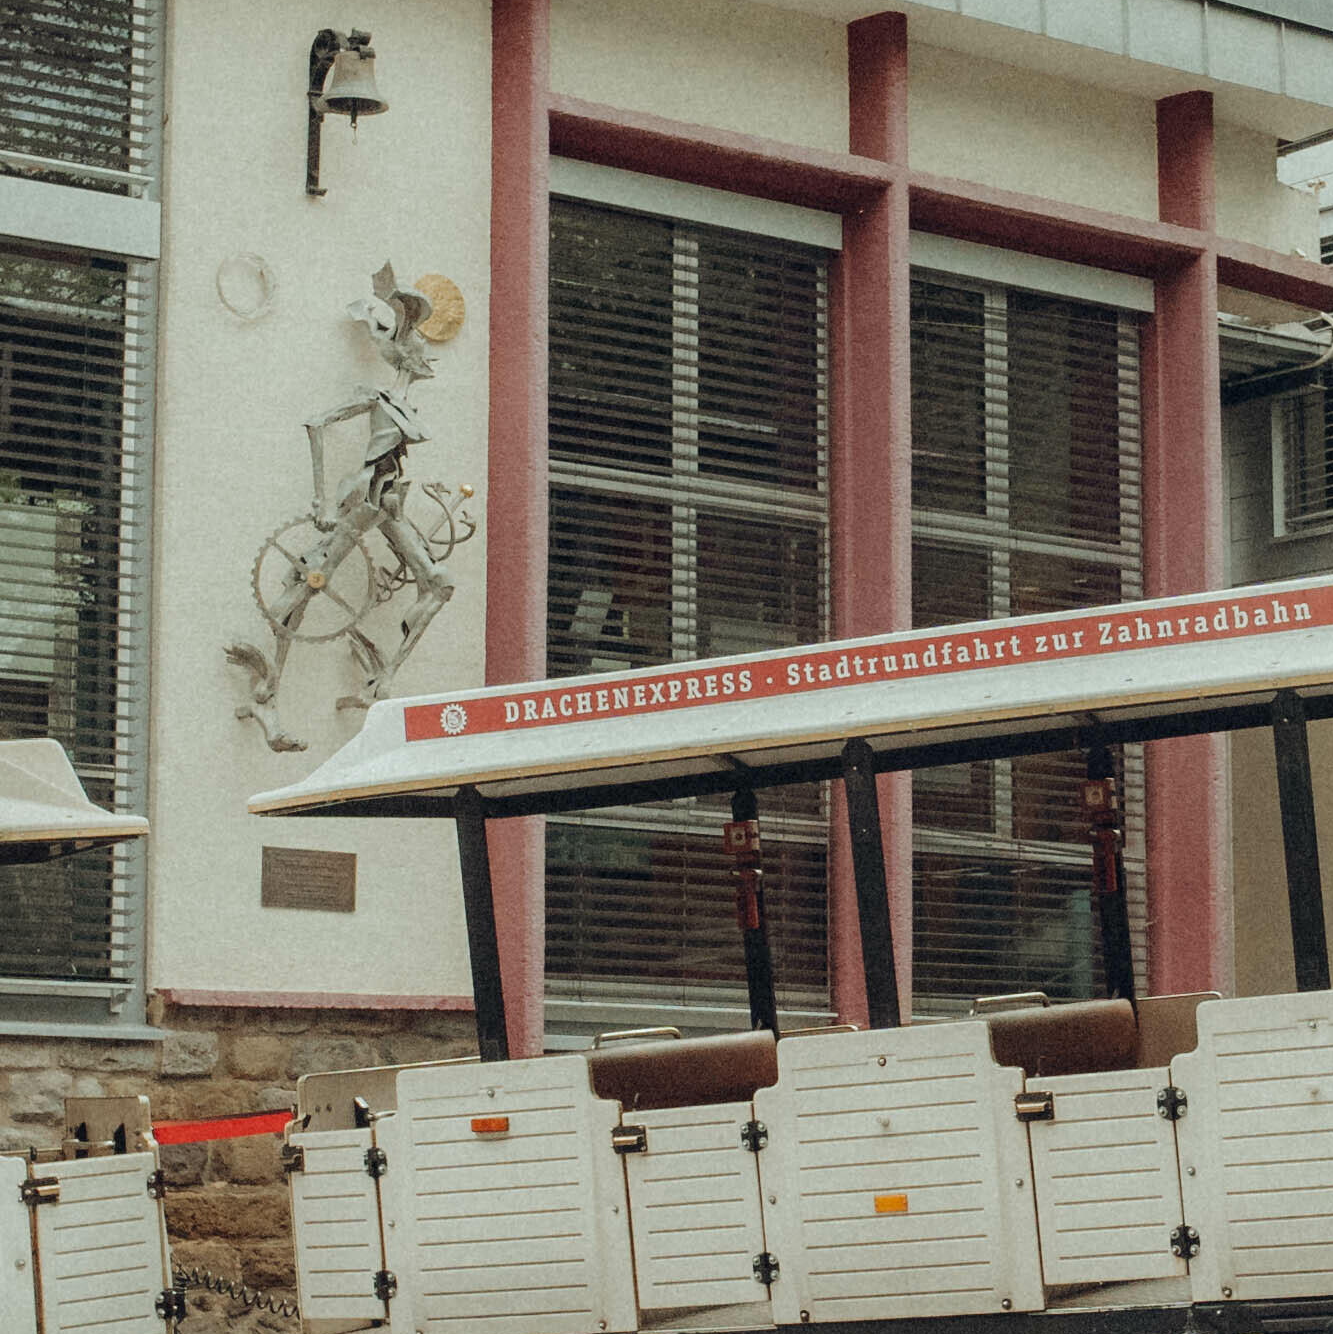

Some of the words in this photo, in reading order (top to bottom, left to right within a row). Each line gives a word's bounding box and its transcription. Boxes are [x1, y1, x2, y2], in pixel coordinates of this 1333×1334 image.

[504, 669, 754, 724] DRACHENEXPRESS
[786, 635, 1022, 685] Stadtrundfahrt
[1035, 629, 1085, 654] zur
[1098, 599, 1313, 646] Zahnradbahn
